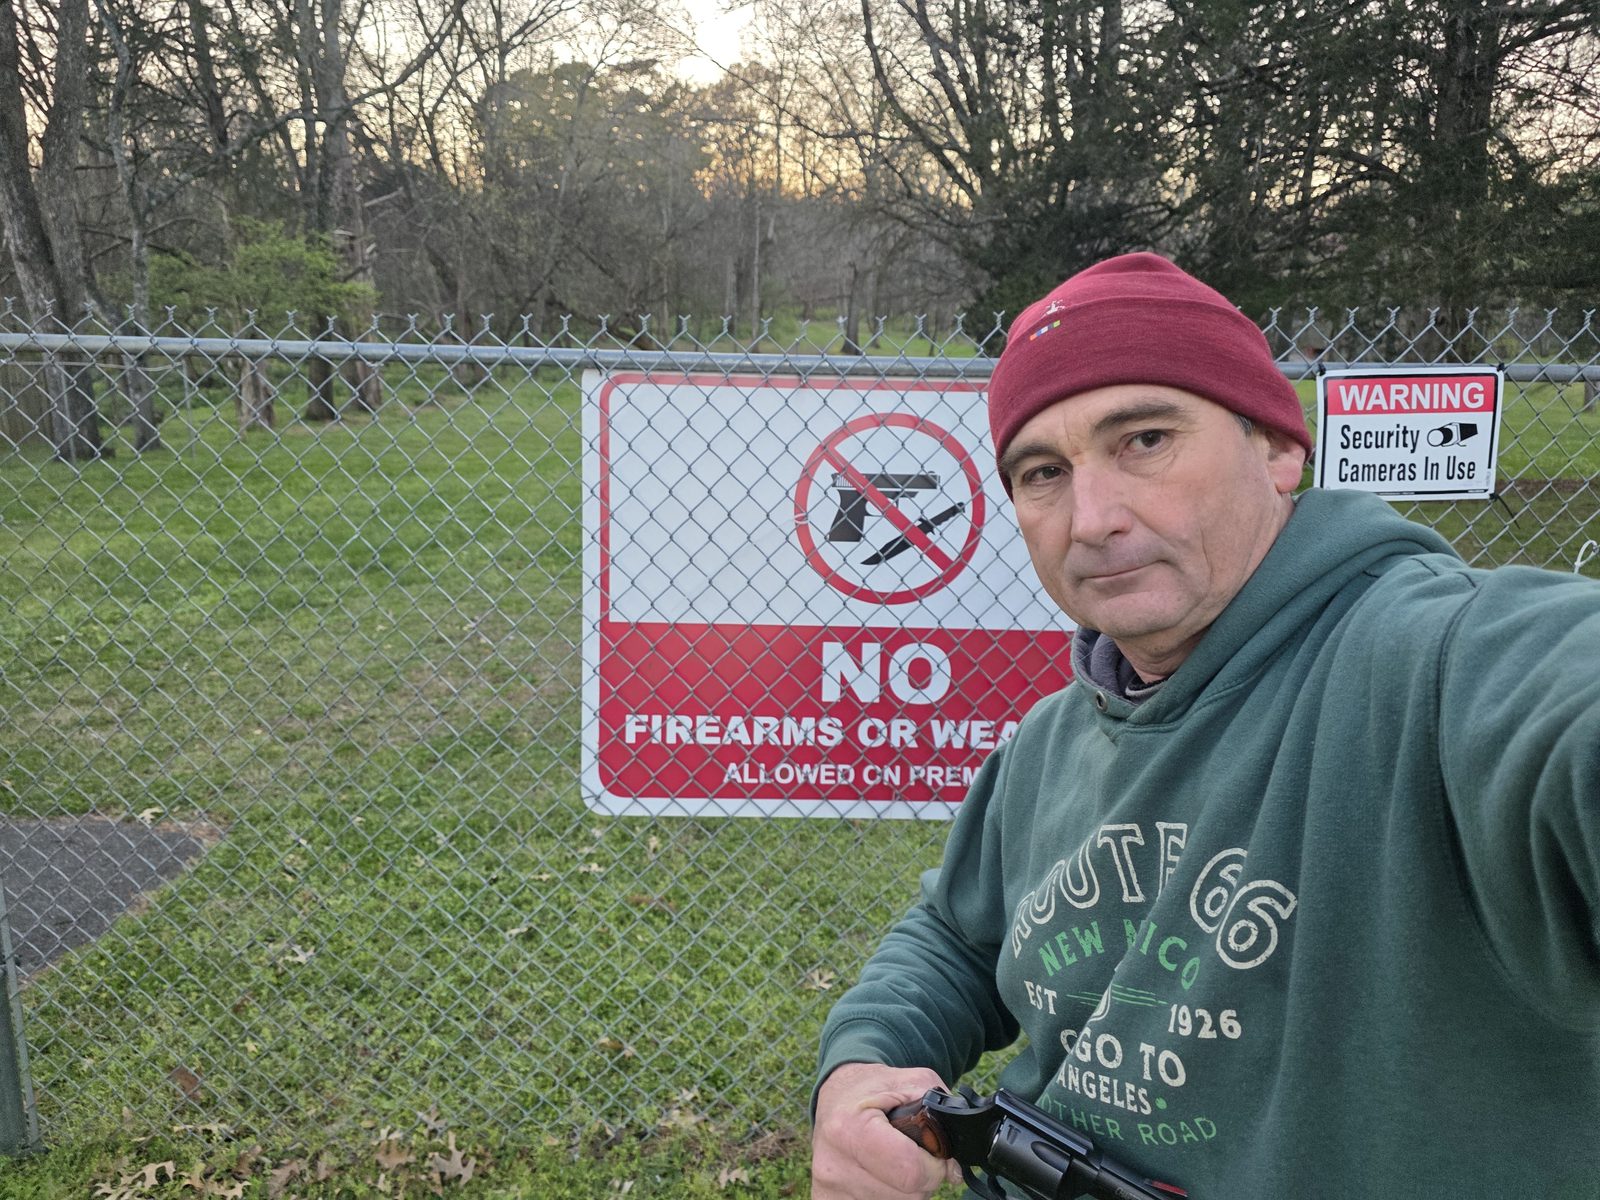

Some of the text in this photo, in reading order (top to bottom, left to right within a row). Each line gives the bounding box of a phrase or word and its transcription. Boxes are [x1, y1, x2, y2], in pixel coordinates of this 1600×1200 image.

[1339, 382, 1484, 411] WARNING
[1340, 424, 1420, 453] Security
[1339, 457, 1416, 482] Cameras
[1424, 456, 1440, 481] In
[1446, 455, 1476, 480] Use
[821, 641, 952, 705] NO
[625, 714, 1019, 749] FIREARMS OR WEA
[723, 763, 981, 787] ALLOWED ON PREM
[1189, 847, 1298, 970] 66
[1038, 920, 1105, 977] NEW
[1023, 980, 1242, 1040] EST 1926
[1139, 1042, 1187, 1088] TO
[1055, 1062, 1152, 1116] ANGELES
[1137, 1114, 1218, 1146] ROAD
